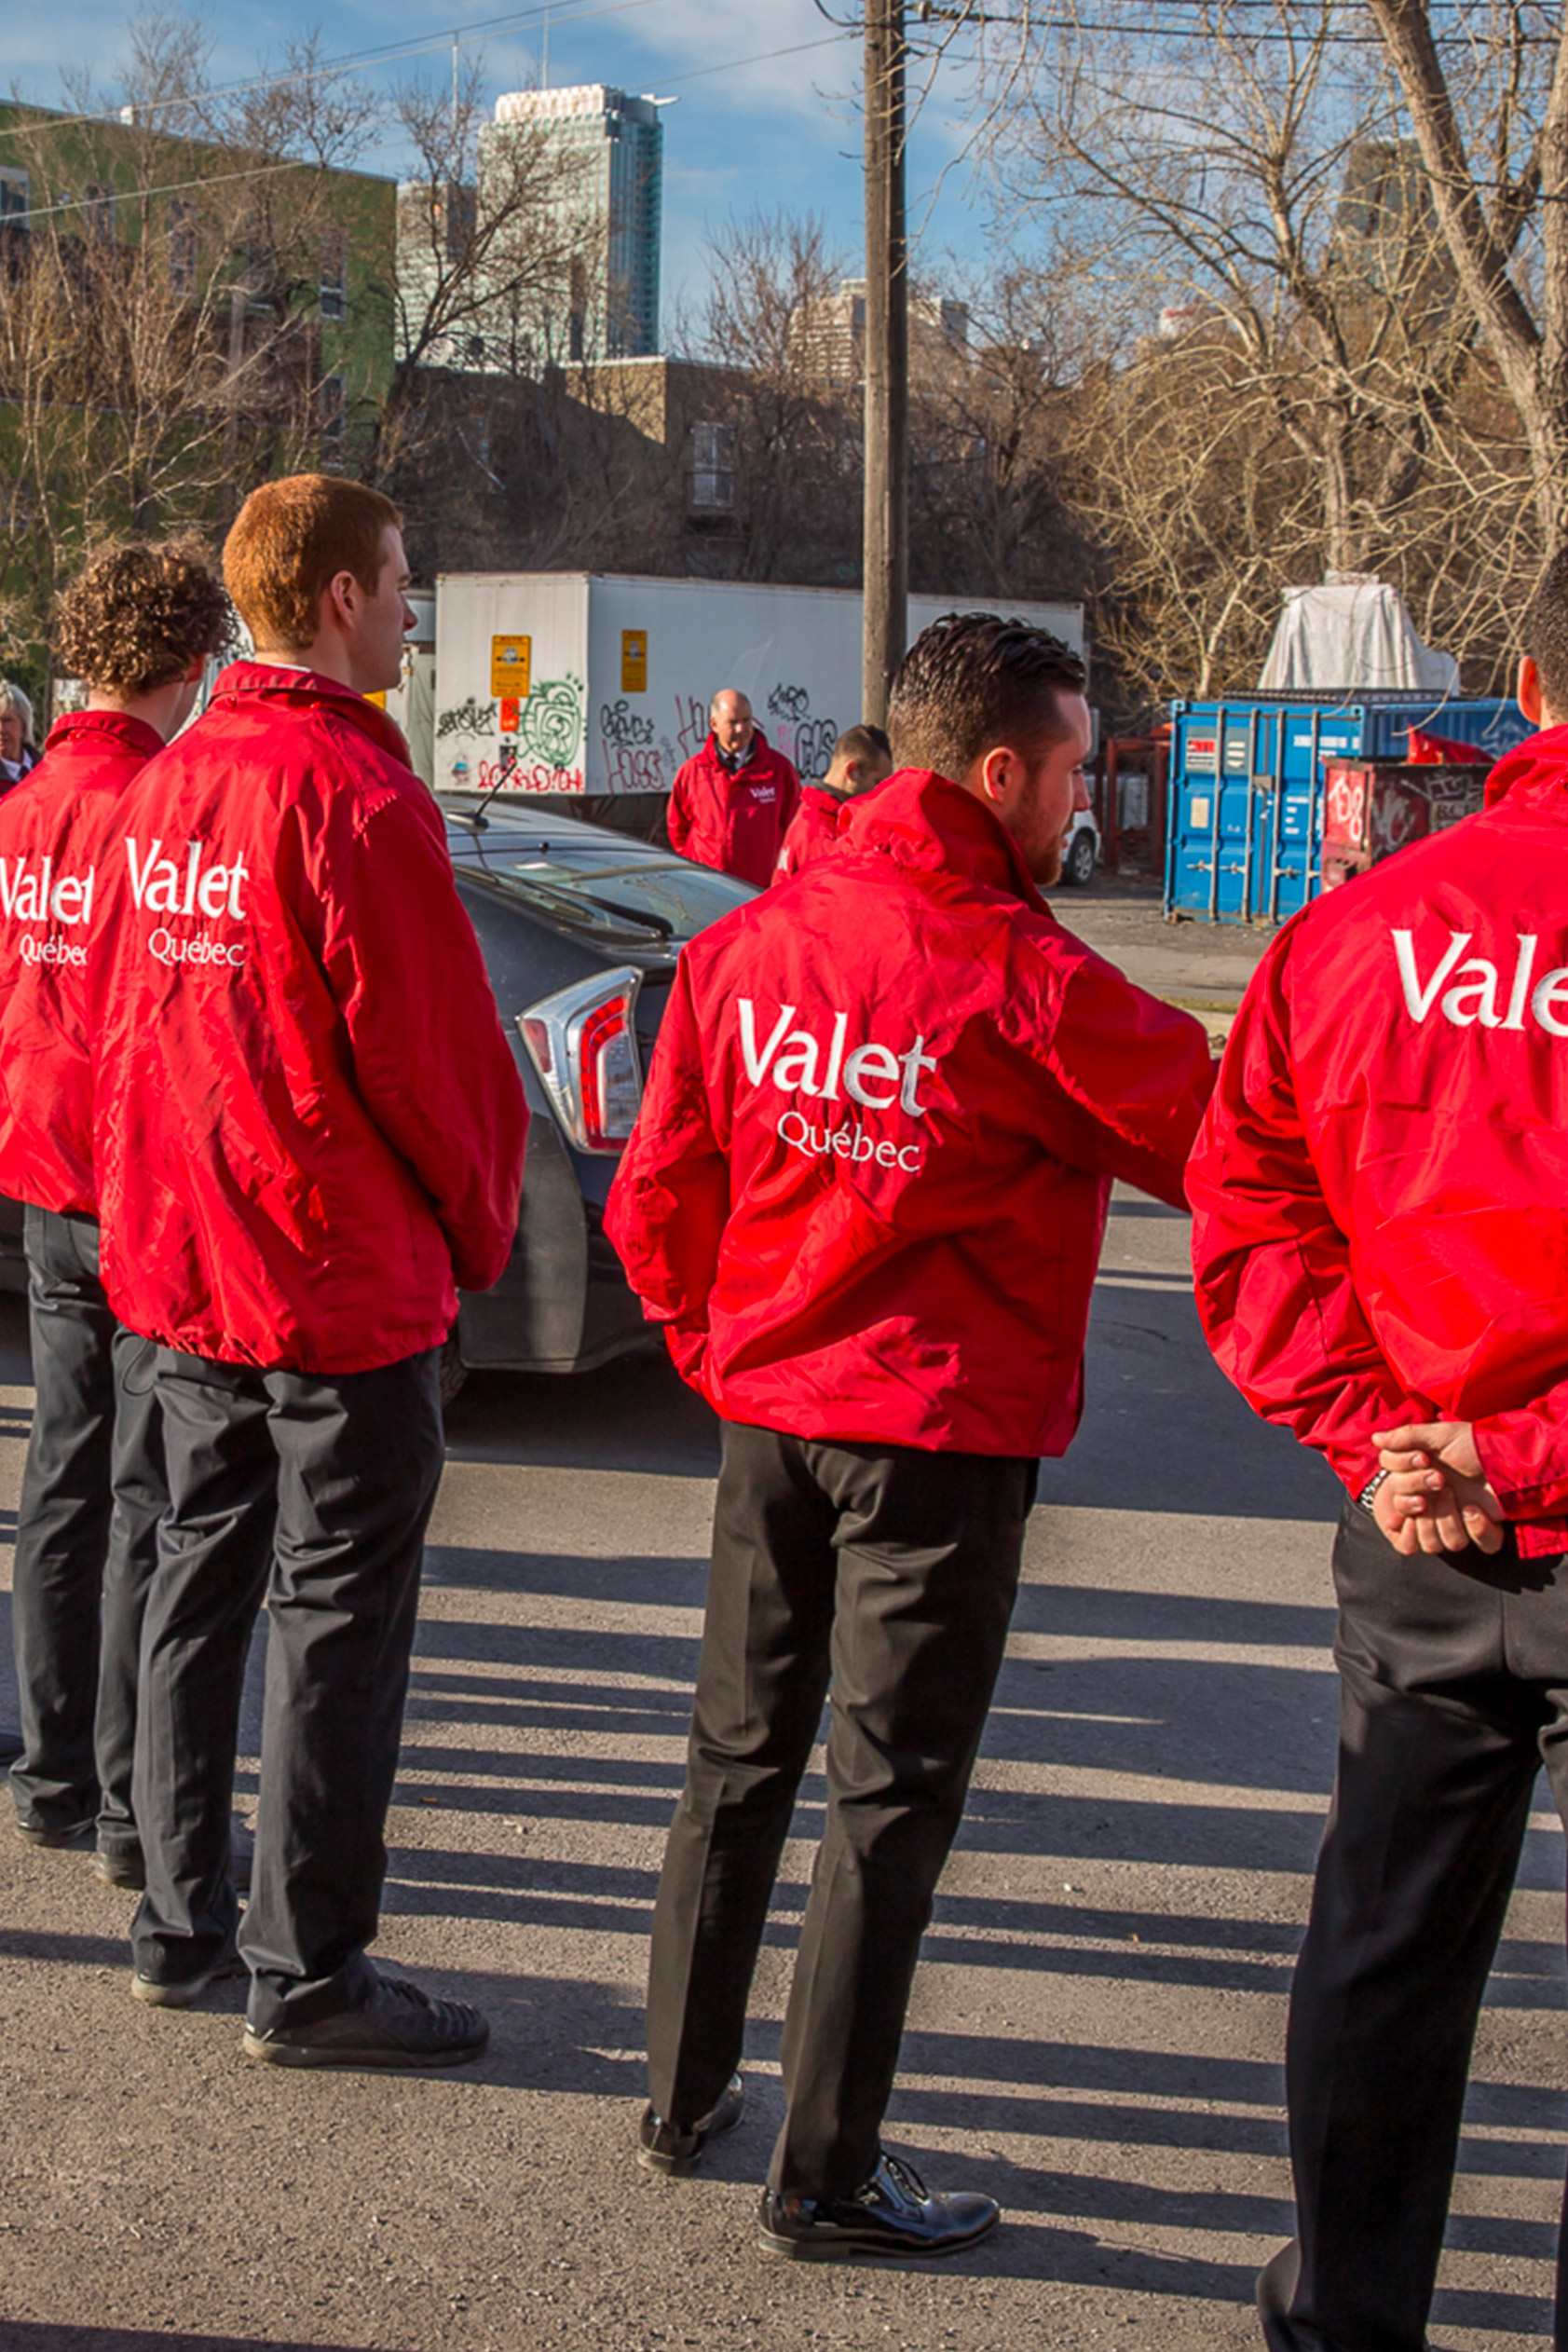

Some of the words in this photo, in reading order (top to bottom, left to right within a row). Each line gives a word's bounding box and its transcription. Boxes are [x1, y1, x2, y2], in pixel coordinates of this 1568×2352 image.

[0, 856, 95, 924] Valet
[125, 837, 249, 920] Valet
[20, 934, 88, 966] Québec
[149, 927, 245, 966] Québec
[1390, 929, 1568, 1036] Vale
[738, 998, 936, 1117] Valet
[777, 1112, 920, 1172] Québec
